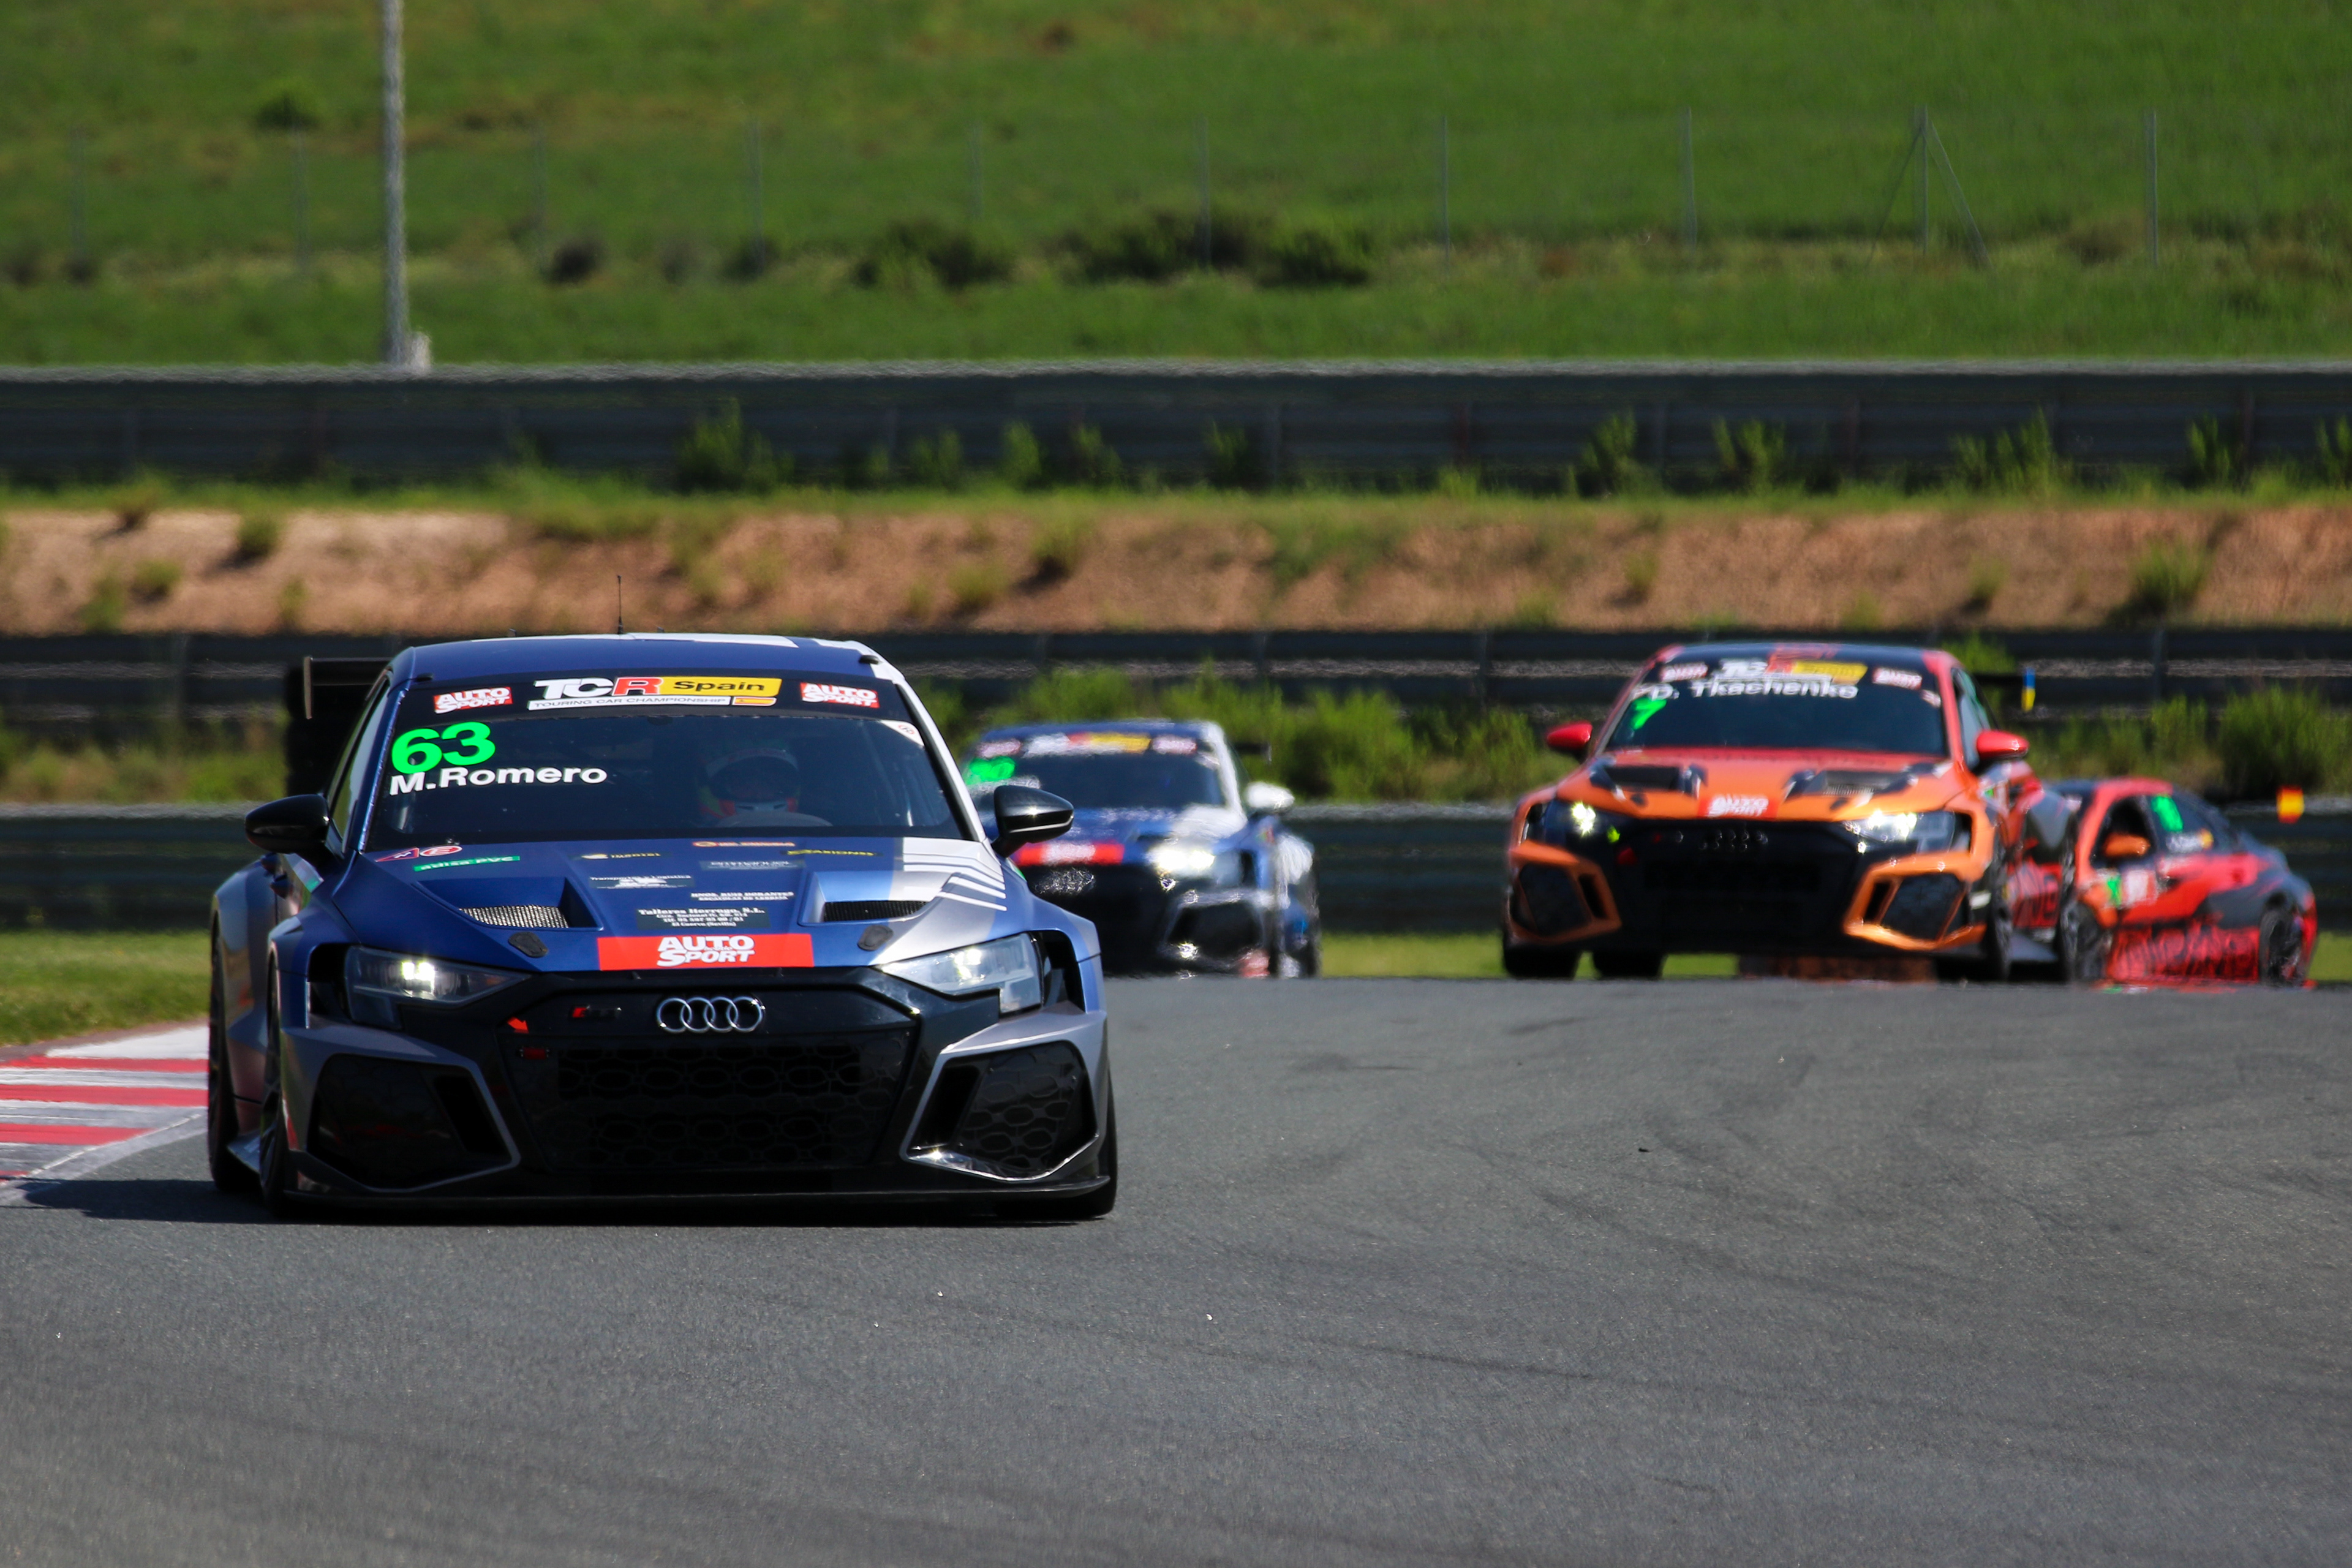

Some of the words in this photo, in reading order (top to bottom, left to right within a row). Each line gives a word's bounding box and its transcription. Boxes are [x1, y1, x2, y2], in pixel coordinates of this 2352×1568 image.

[437, 687, 510, 705] AUTO
[533, 677, 664, 699] TCR
[673, 680, 765, 692] Spain
[803, 683, 876, 700] AUTO
[1691, 680, 1858, 699] Tkachenko
[435, 696, 510, 714] SPORT
[802, 693, 878, 707] SPORT
[1632, 697, 1667, 730] 7
[391, 722, 496, 774] 63
[390, 766, 608, 796] M.Romero
[657, 935, 755, 951] AUTO
[657, 949, 756, 967] SPORT
